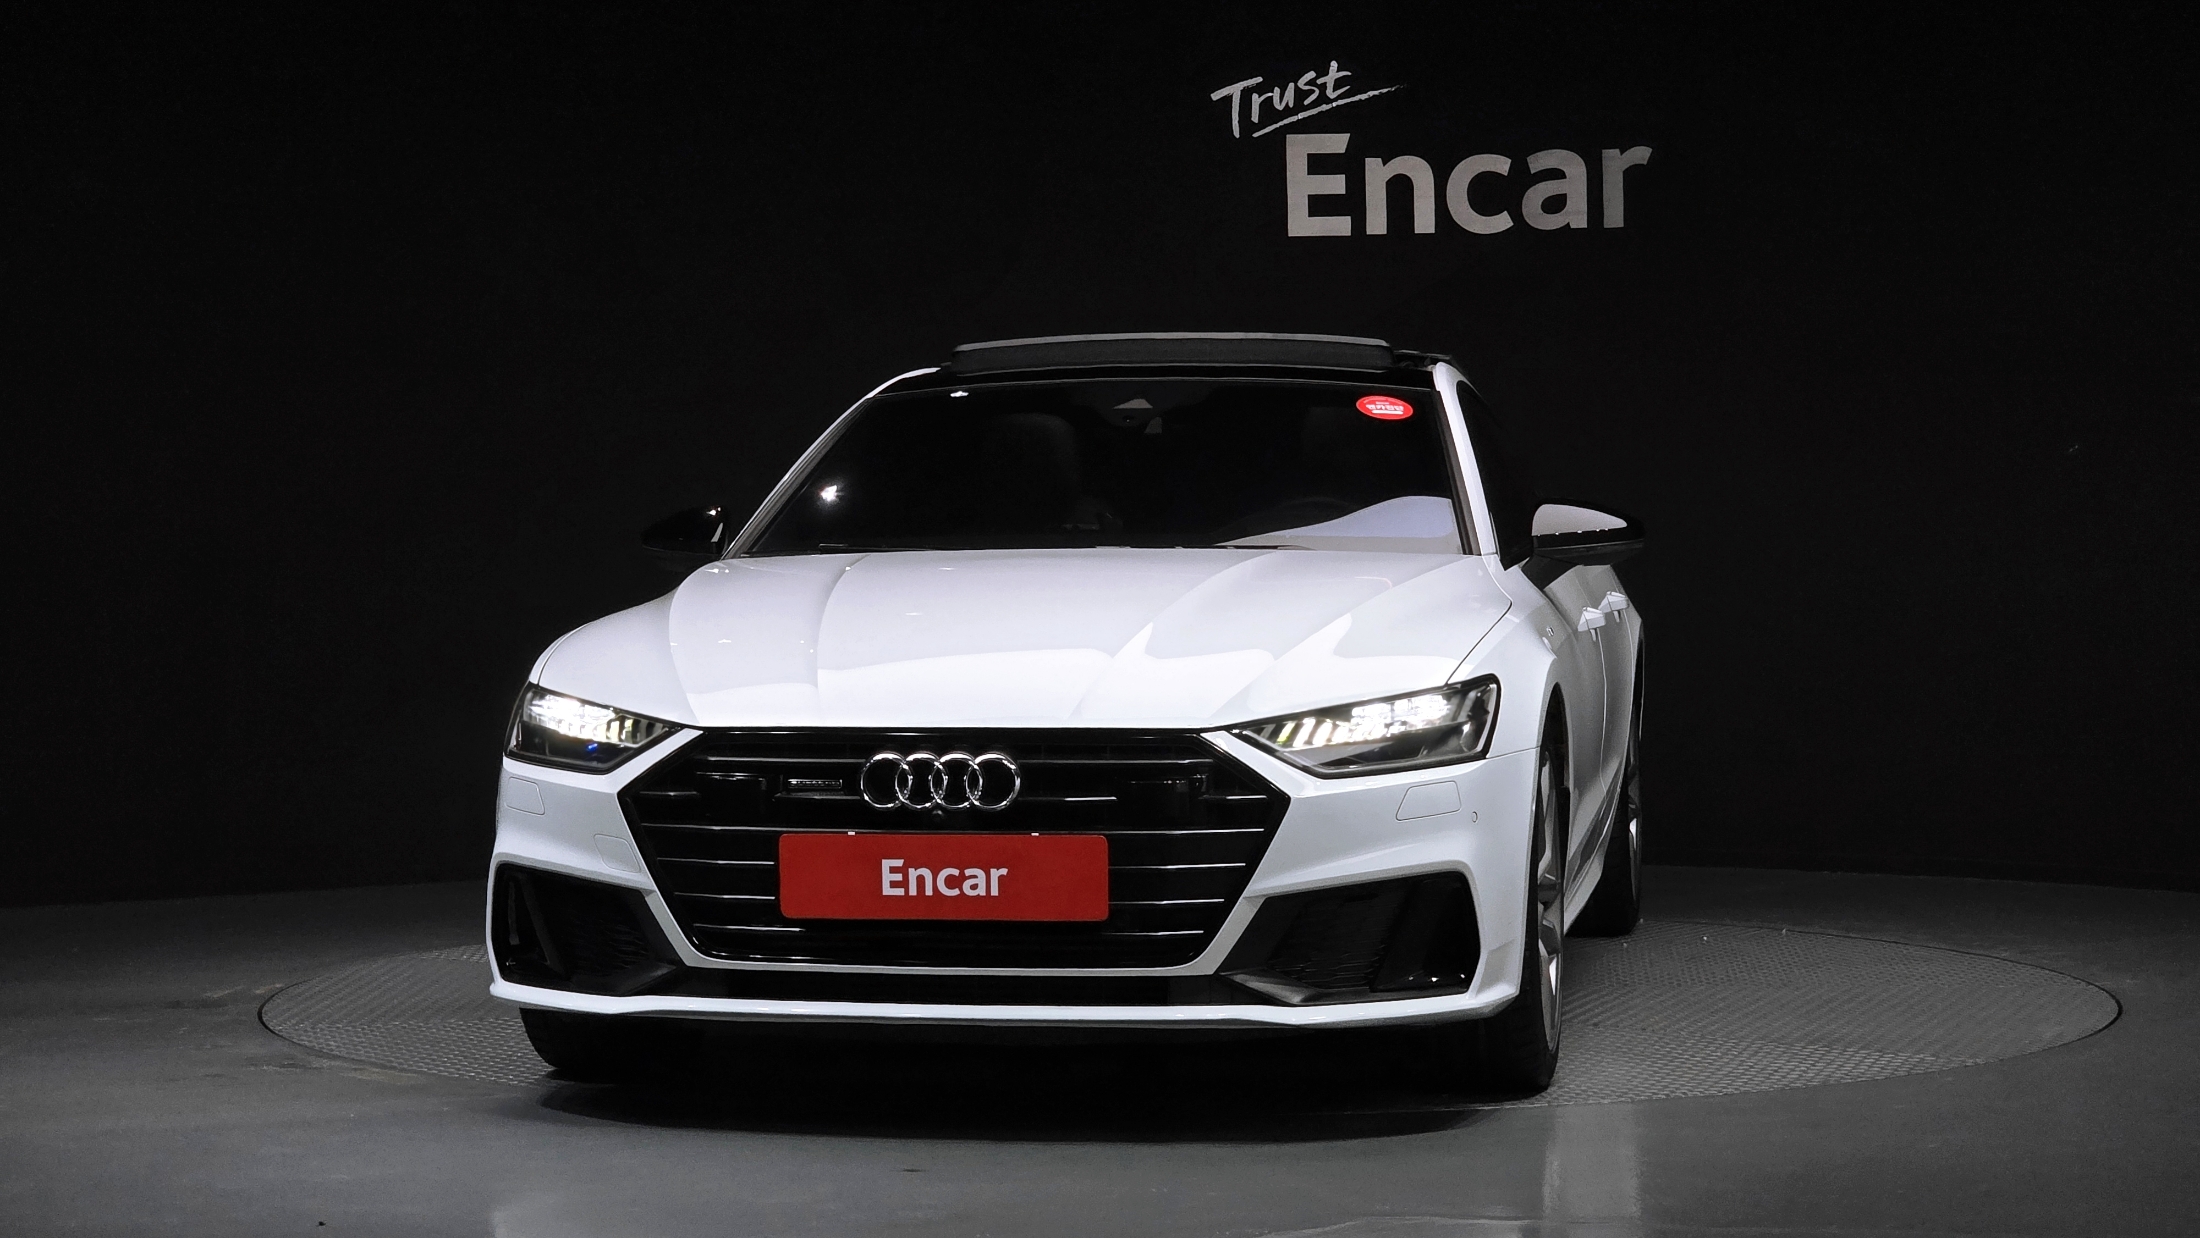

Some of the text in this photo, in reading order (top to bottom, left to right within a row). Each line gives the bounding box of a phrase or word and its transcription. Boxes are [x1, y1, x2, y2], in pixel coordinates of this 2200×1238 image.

[1211, 60, 1352, 139] Trust
[1285, 132, 1653, 237] Encar
[881, 858, 1008, 897] Encar
